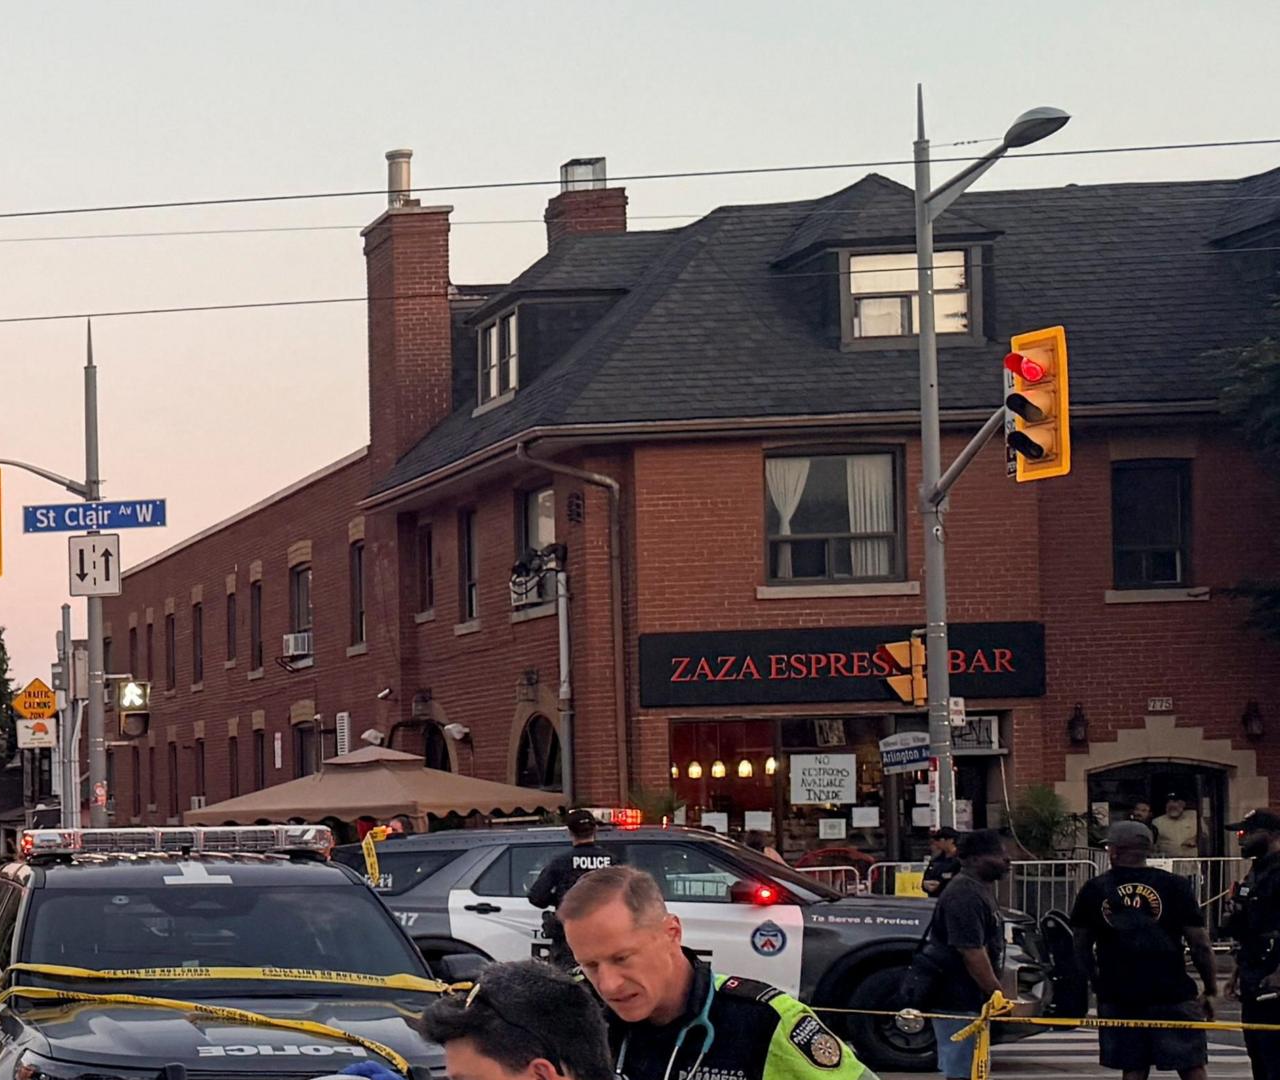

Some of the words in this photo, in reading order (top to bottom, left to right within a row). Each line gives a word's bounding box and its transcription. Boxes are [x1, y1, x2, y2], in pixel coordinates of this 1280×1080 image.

[36, 509, 56, 527] St
[64, 506, 111, 526] Clair
[118, 504, 132, 516] Av
[135, 504, 153, 523] W
[670, 656, 762, 682] ZAZA
[948, 648, 1016, 675] BAR
[882, 748, 919, 763] Arlington
[572, 856, 612, 871] POLICE
[811, 914, 825, 922] To
[828, 915, 860, 923] Serve
[876, 917, 920, 926] Protect
